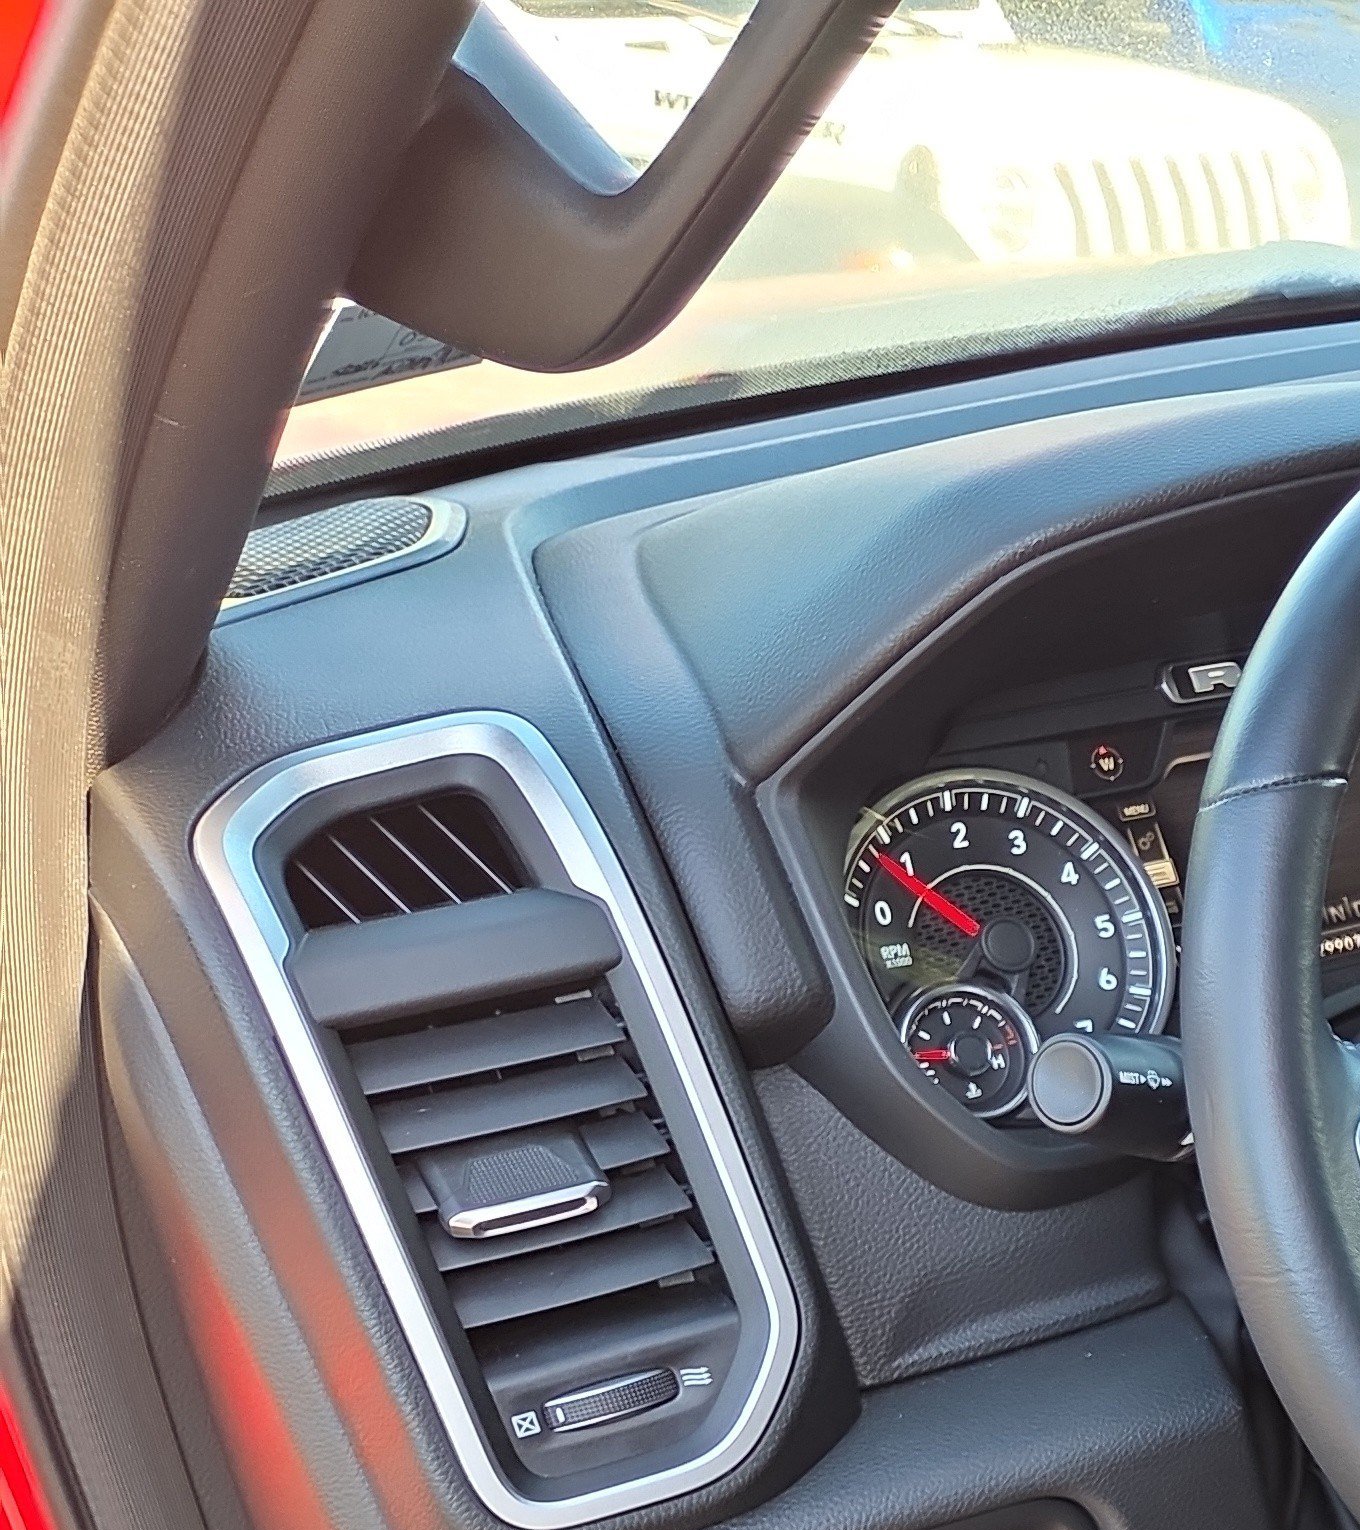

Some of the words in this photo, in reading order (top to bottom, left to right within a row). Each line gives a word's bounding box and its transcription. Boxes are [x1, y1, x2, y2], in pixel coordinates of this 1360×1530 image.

[1098, 756, 1115, 772] W
[950, 821, 970, 849] 2
[1007, 829, 1027, 855] 3
[899, 851, 915, 877] 1
[1060, 861, 1080, 886] 4
[874, 900, 892, 926] 0
[1093, 912, 1115, 939] 5
[880, 942, 911, 960] RPM
[1099, 967, 1118, 990] 6
[989, 1052, 1006, 1071] H
